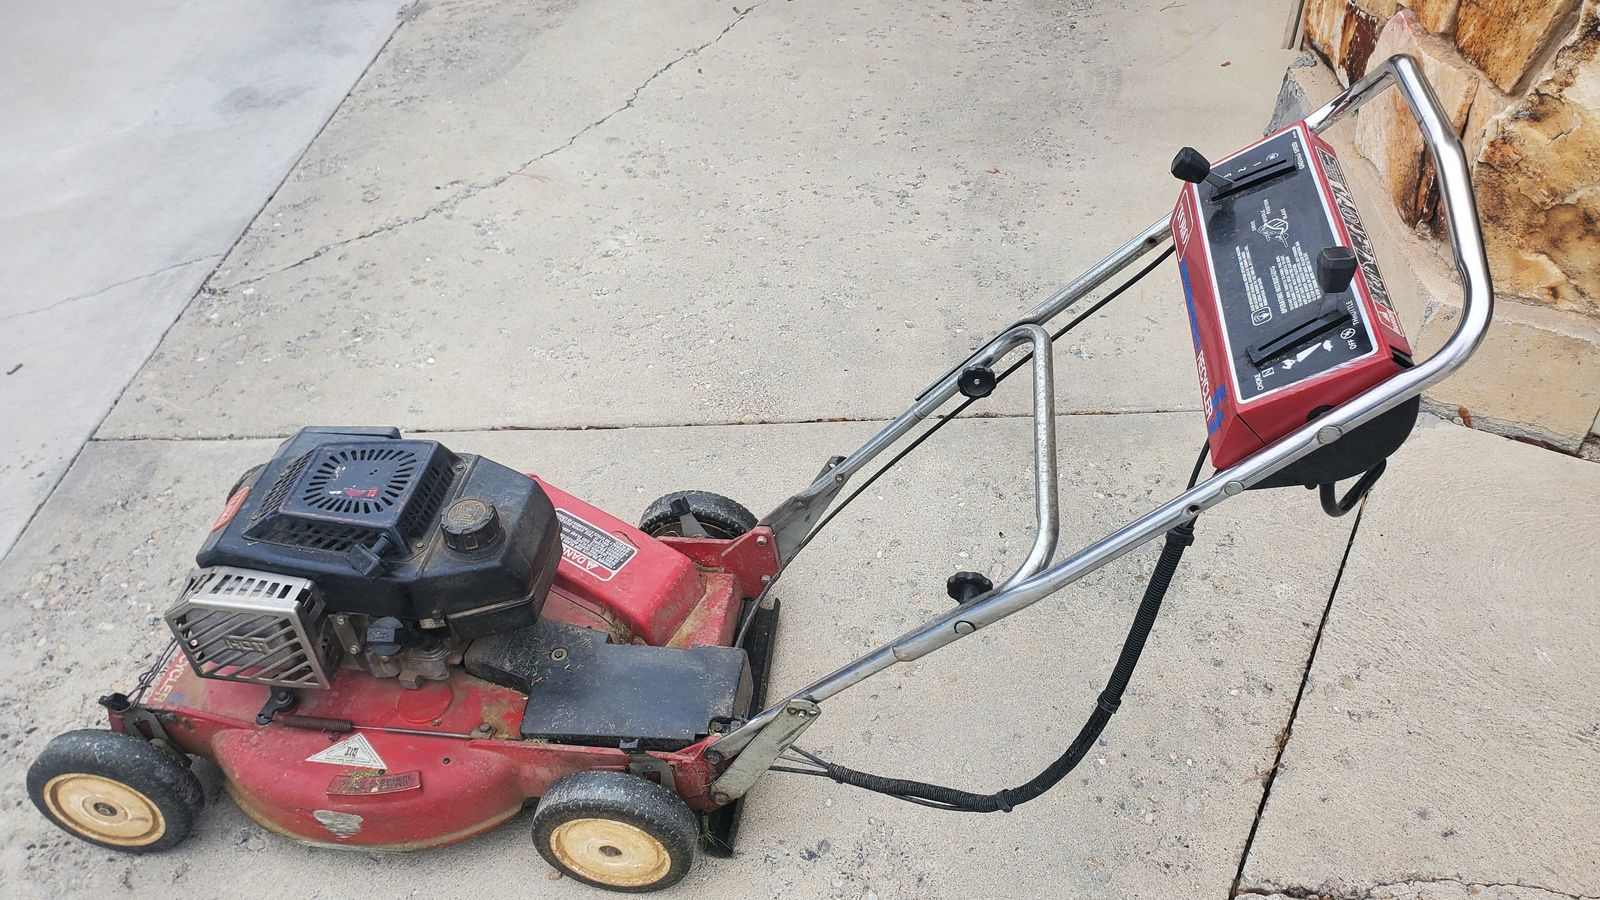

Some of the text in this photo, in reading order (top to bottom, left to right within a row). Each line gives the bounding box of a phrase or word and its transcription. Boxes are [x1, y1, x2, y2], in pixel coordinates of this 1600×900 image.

[1177, 202, 1188, 245] TORO
[1269, 266, 1282, 293] INSTRUCTIONS
[1275, 292, 1288, 314] OPERATING
[1347, 339, 1358, 350] OFF
[1197, 349, 1213, 422] RECYCLER
[1253, 373, 1264, 391] CHOKE
[562, 546, 587, 565] DAN
[153, 655, 188, 703] CYCLER
